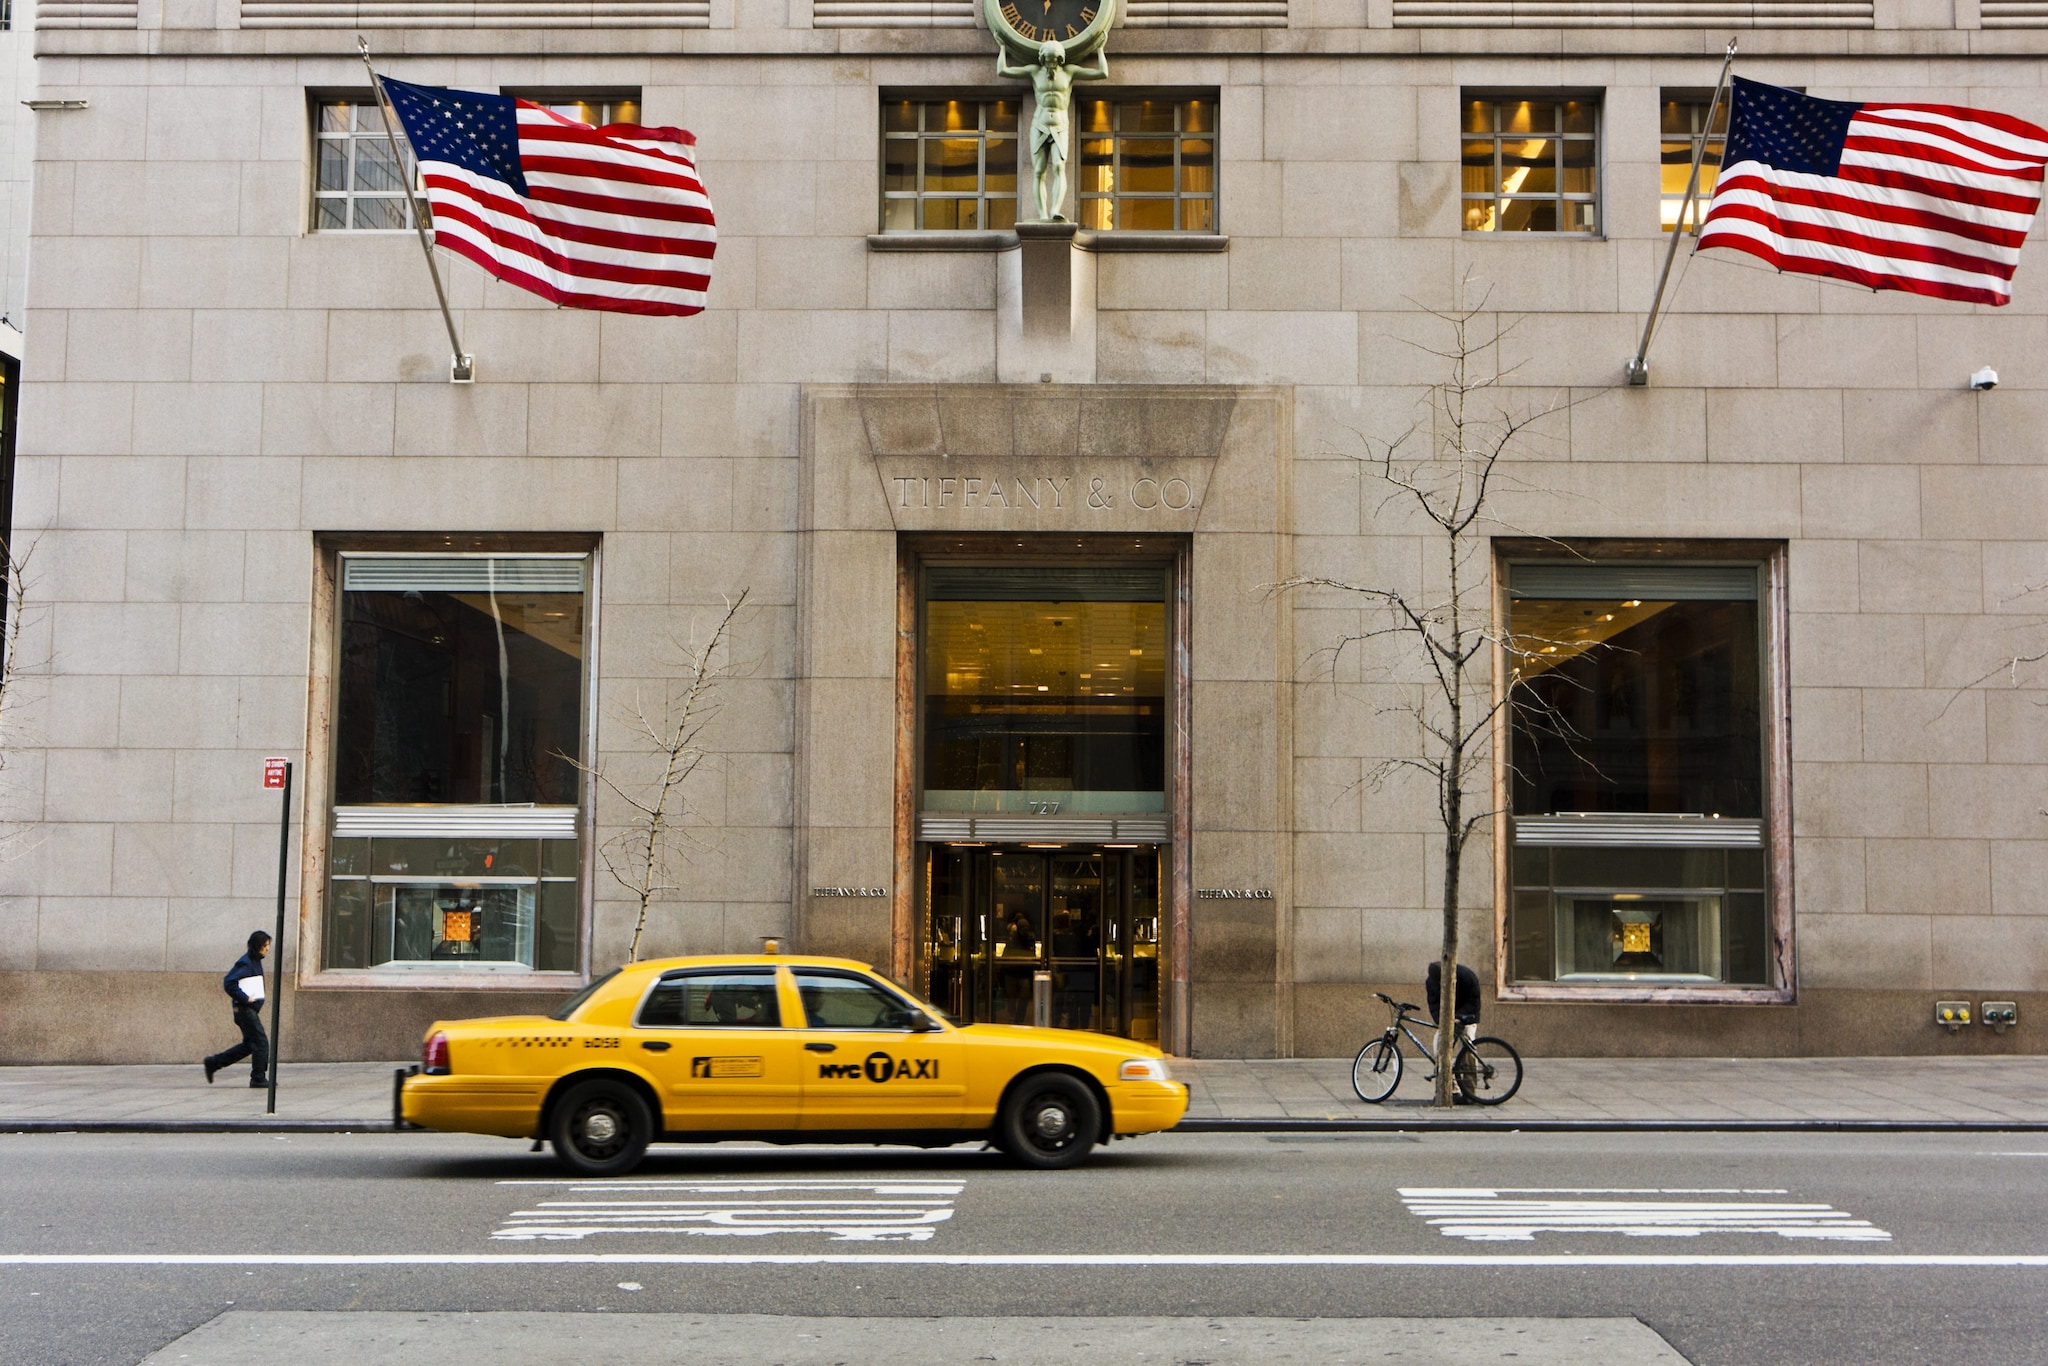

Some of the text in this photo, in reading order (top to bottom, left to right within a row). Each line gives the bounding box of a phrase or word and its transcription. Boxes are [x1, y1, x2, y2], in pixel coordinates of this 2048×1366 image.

[893, 477, 1196, 510] TIFFANY & CO.
[1029, 801, 1060, 815] 727
[814, 887, 858, 897] TIFFANY
[860, 887, 867, 897] &
[1198, 889, 1273, 899] TIFFANY & CO.
[819, 1055, 939, 1080] NYC TAXI
